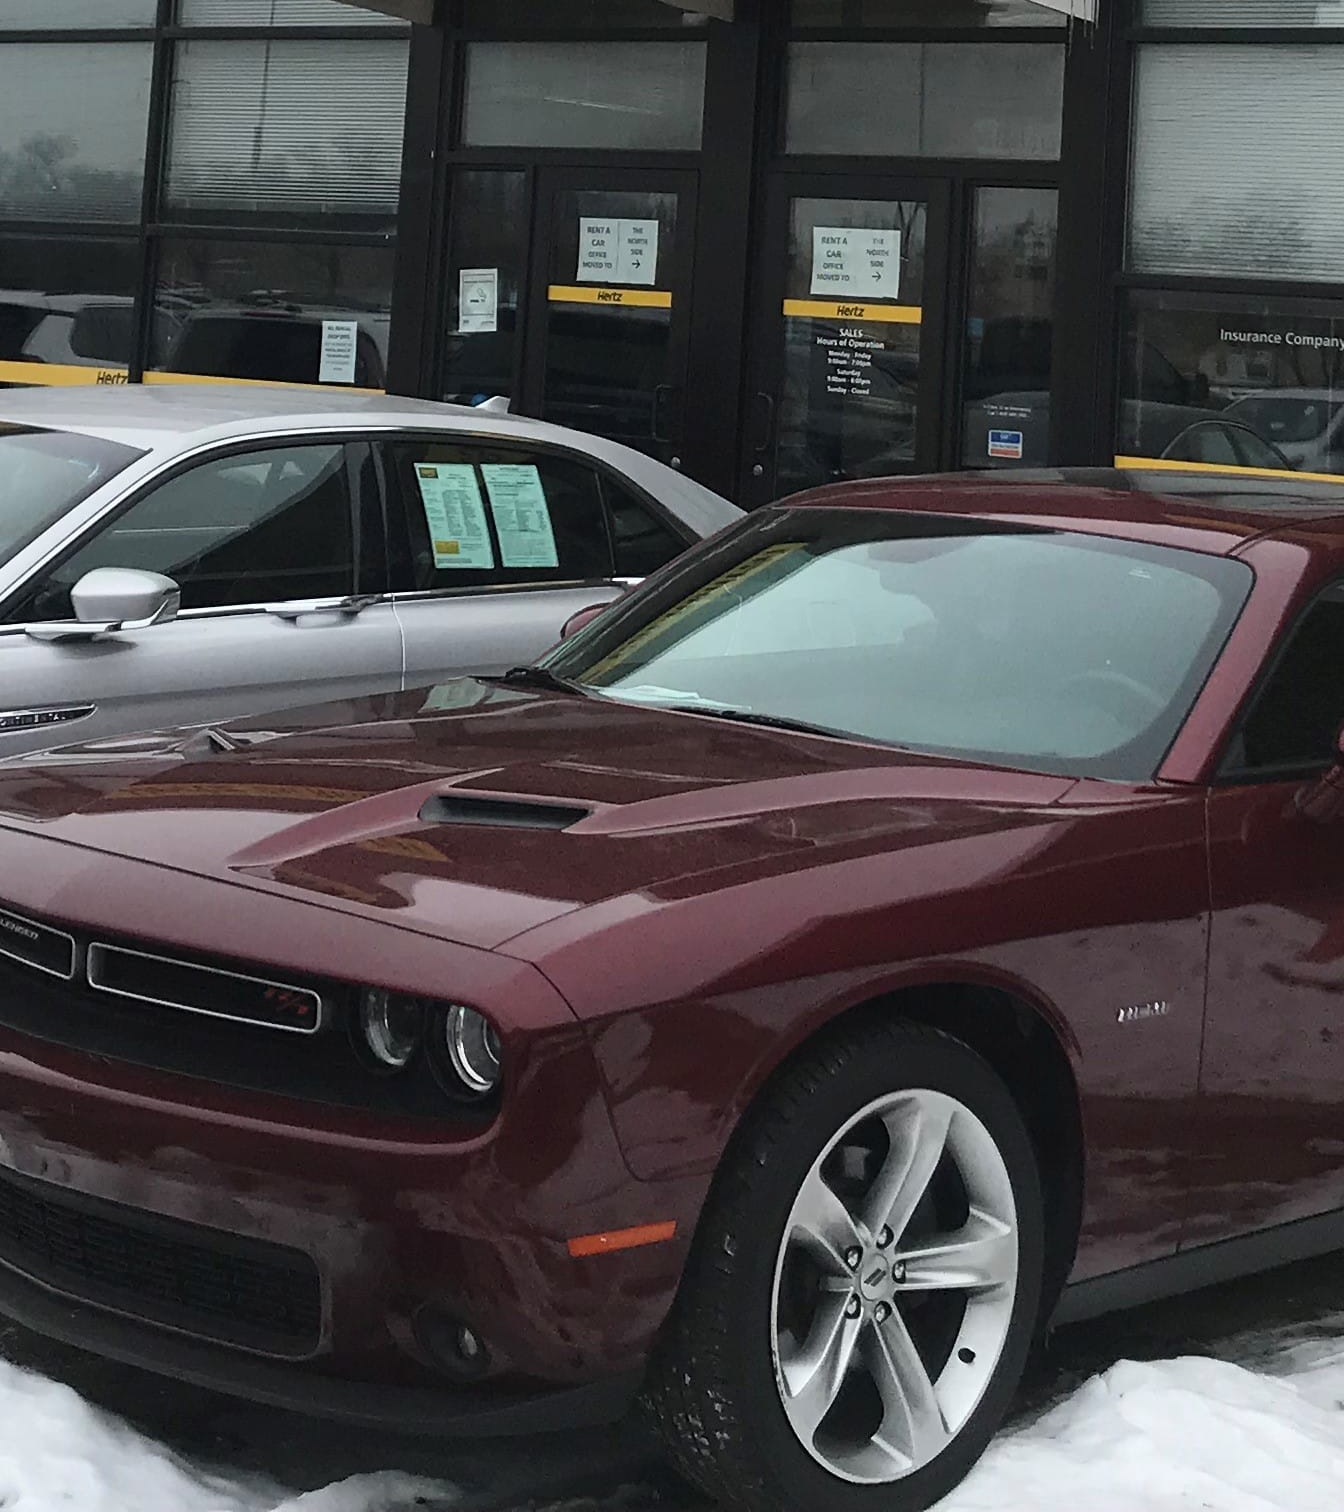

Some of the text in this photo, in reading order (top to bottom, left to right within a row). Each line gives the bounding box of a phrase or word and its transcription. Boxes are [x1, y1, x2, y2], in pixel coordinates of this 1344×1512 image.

[591, 239, 605, 247] CAR
[821, 236, 848, 245] RENT A
[826, 249, 842, 258] CAR
[597, 290, 623, 302] Hertz
[836, 305, 865, 317] Hertz
[839, 328, 864, 338] SALES
[1220, 328, 1282, 344] Insurance
[816, 336, 885, 350] Hours of Operation
[96, 370, 128, 385] Hertz
